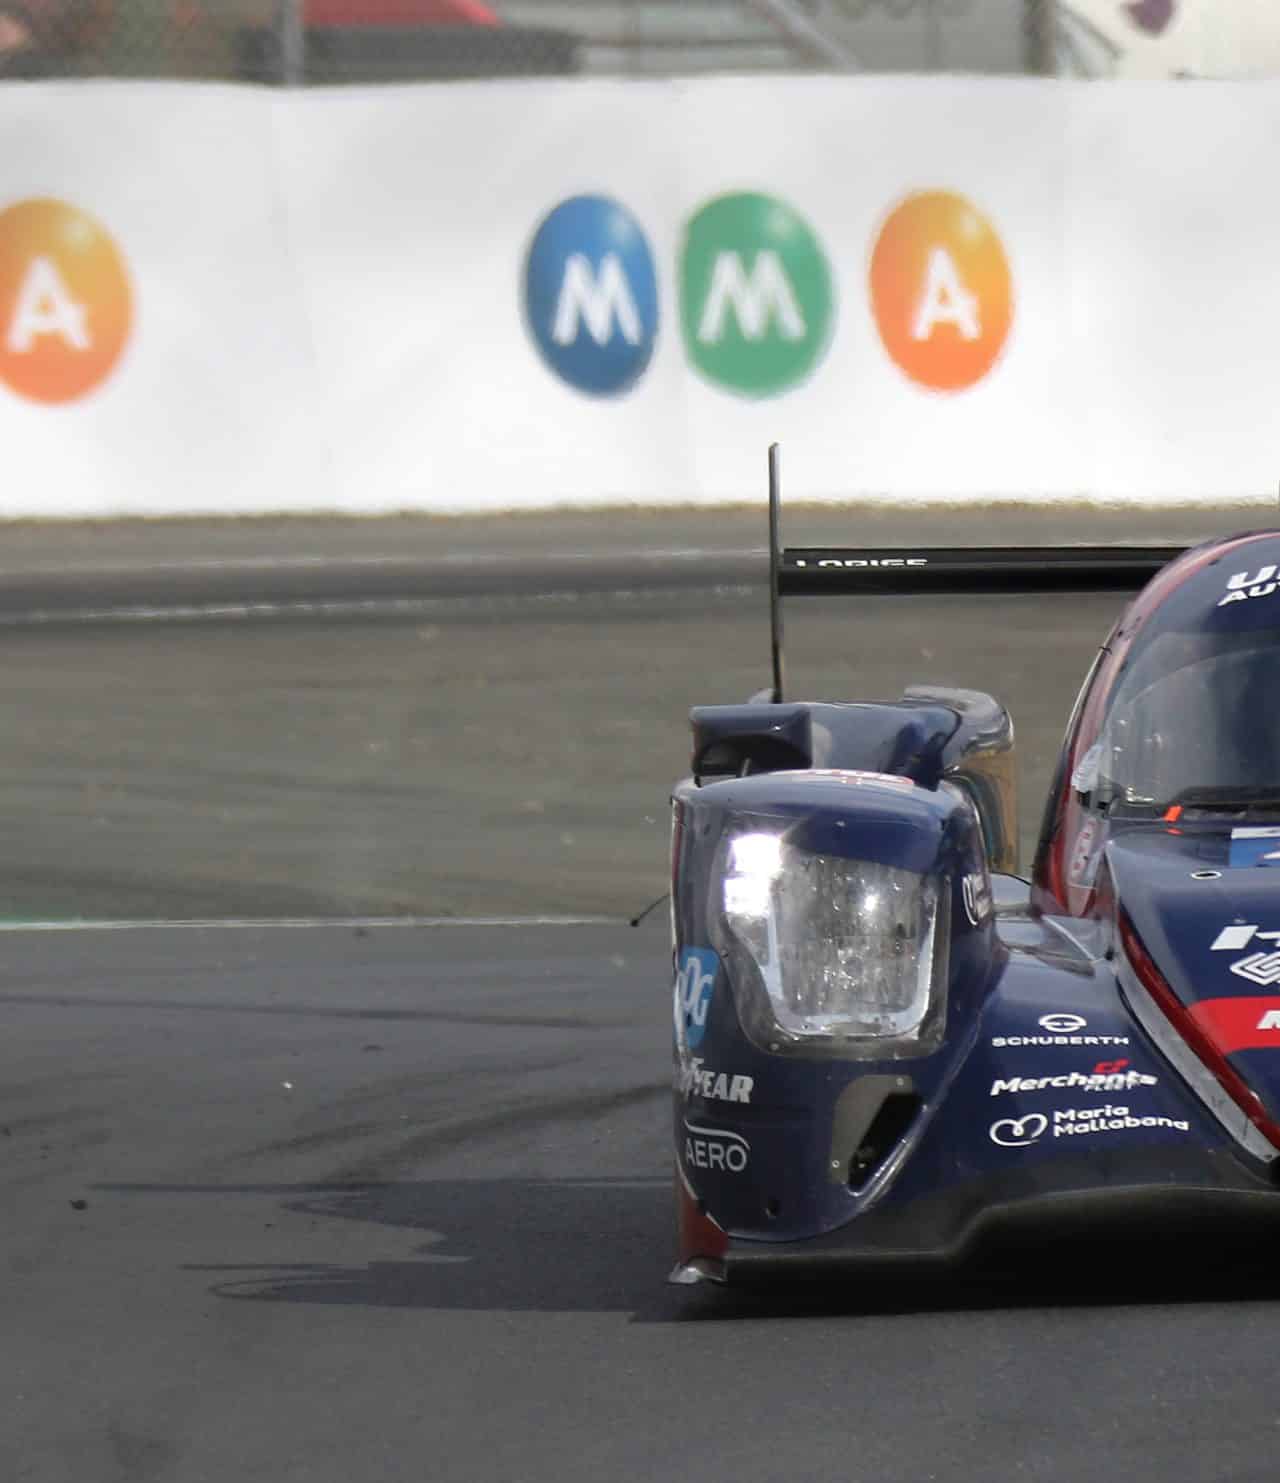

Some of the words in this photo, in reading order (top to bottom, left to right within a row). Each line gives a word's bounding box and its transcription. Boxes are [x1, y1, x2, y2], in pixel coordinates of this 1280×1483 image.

[6, 256, 94, 352] A
[991, 1036, 1130, 1047] SCHUBERTH
[990, 1071, 1159, 1096] Merchants
[1053, 1104, 1130, 1124] Maria
[1053, 1114, 1190, 1138] Mallaband
[686, 1136, 748, 1173] AERO
